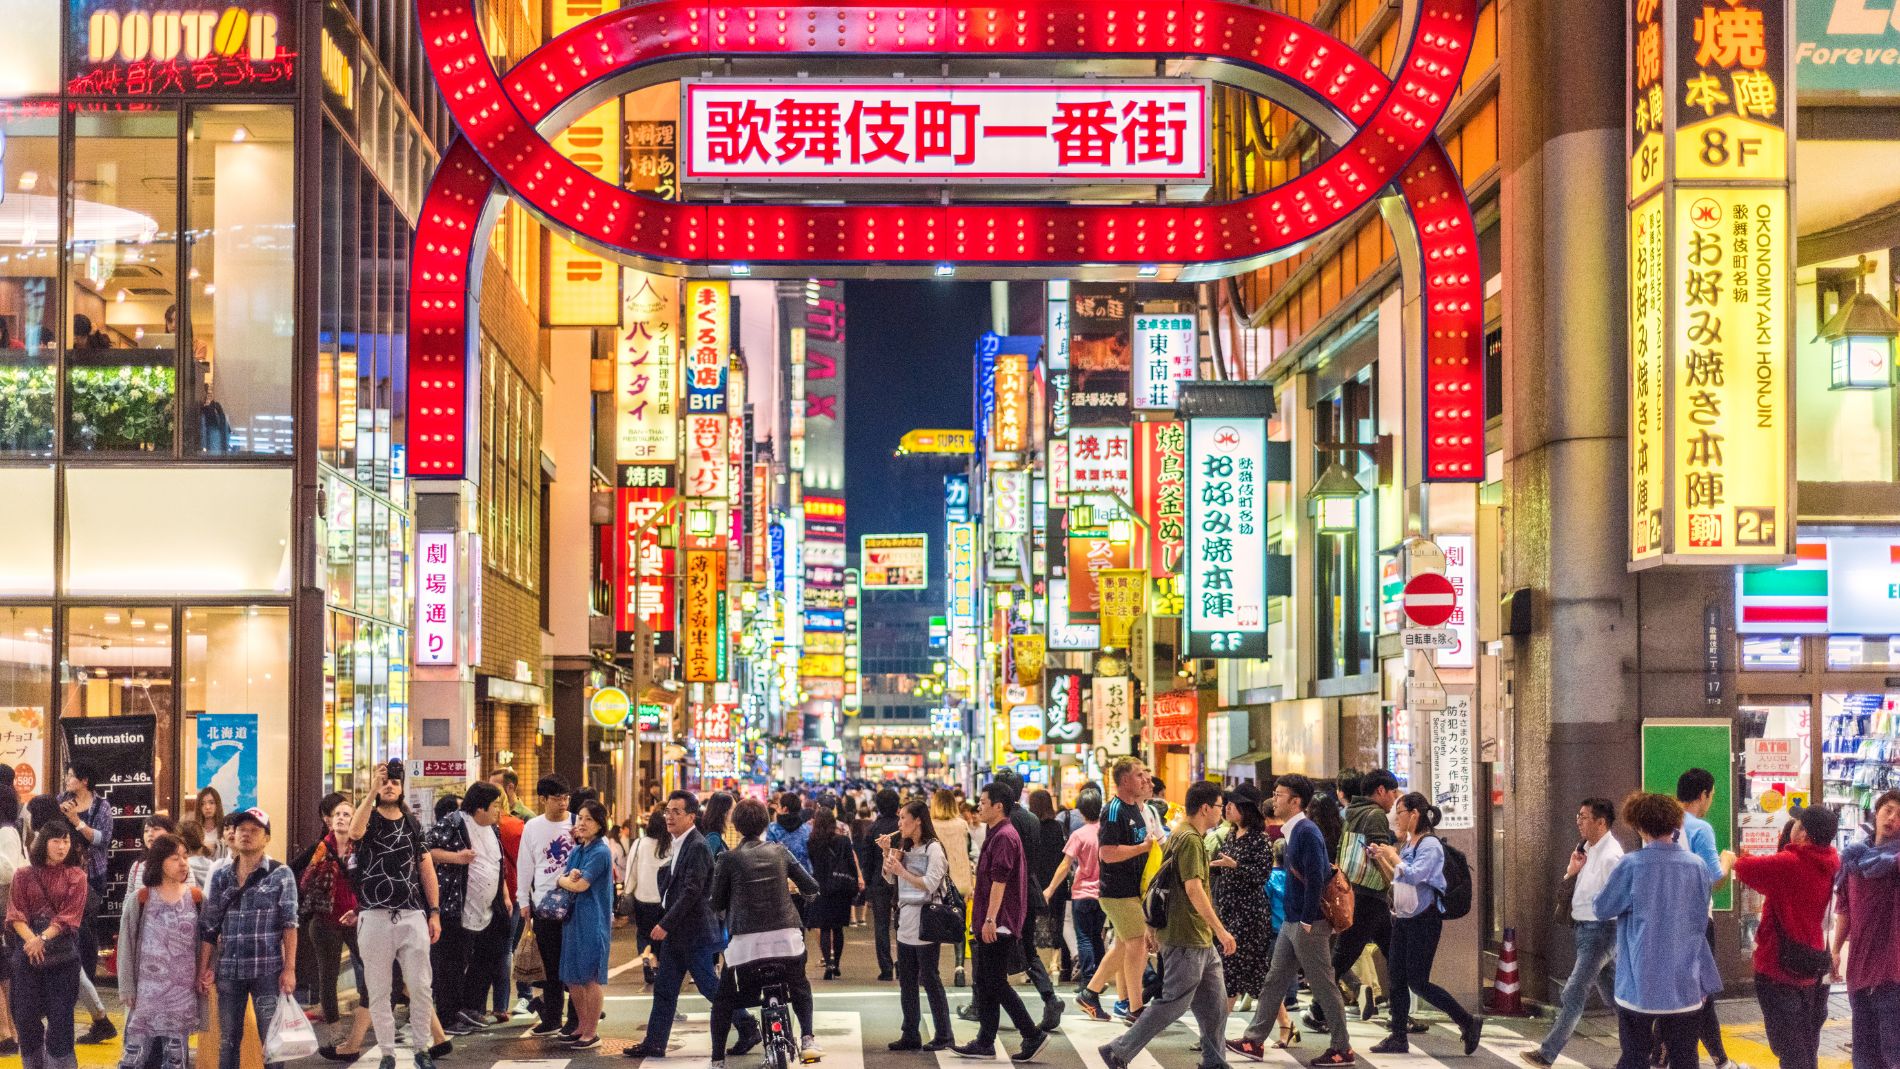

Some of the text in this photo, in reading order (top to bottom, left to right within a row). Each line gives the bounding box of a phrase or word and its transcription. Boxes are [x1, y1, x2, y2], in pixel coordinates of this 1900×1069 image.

[88, 7, 277, 62] DOUTOR
[1825, 0, 1900, 34] L
[1795, 42, 1900, 64] Foreve
[1686, 70, 1776, 117] 本陣
[706, 99, 1187, 166] 歌舞伎町一番街
[1699, 127, 1762, 168] 8F
[1641, 144, 1658, 182] 8F
[1733, 204, 1748, 303] 歌舞伎町名物
[1756, 204, 1772, 428] OKONOMIYAKI HONJIN
[697, 288, 717, 386] まぐろ商店
[626, 321, 653, 421] バンタイ
[658, 322, 669, 415] タイ国料理専門店
[1149, 334, 1168, 405] 東南荘
[1685, 230, 1724, 509] お好み焼き本陣
[690, 394, 724, 410] B1F
[635, 446, 656, 456] 3F
[938, 435, 964, 447] SUPER
[626, 466, 666, 487] 焼肉
[1157, 425, 1183, 570] 焼鳥釜めし
[1738, 512, 1773, 541] 2F
[427, 544, 446, 652] 劇場通り
[1211, 633, 1242, 651] 2F
[1405, 634, 1455, 645] 自転車を除く
[1708, 682, 1720, 691] 17
[0, 731, 32, 743] チョコ
[207, 726, 247, 739] 北海道
[1759, 742, 1787, 752] ATM
[1447, 706, 1459, 806] 防犯カメラ作動中
[1459, 700, 1469, 812] みなさまの安全を守ります
[110, 774, 121, 782] 4F
[112, 806, 122, 815] 3F
